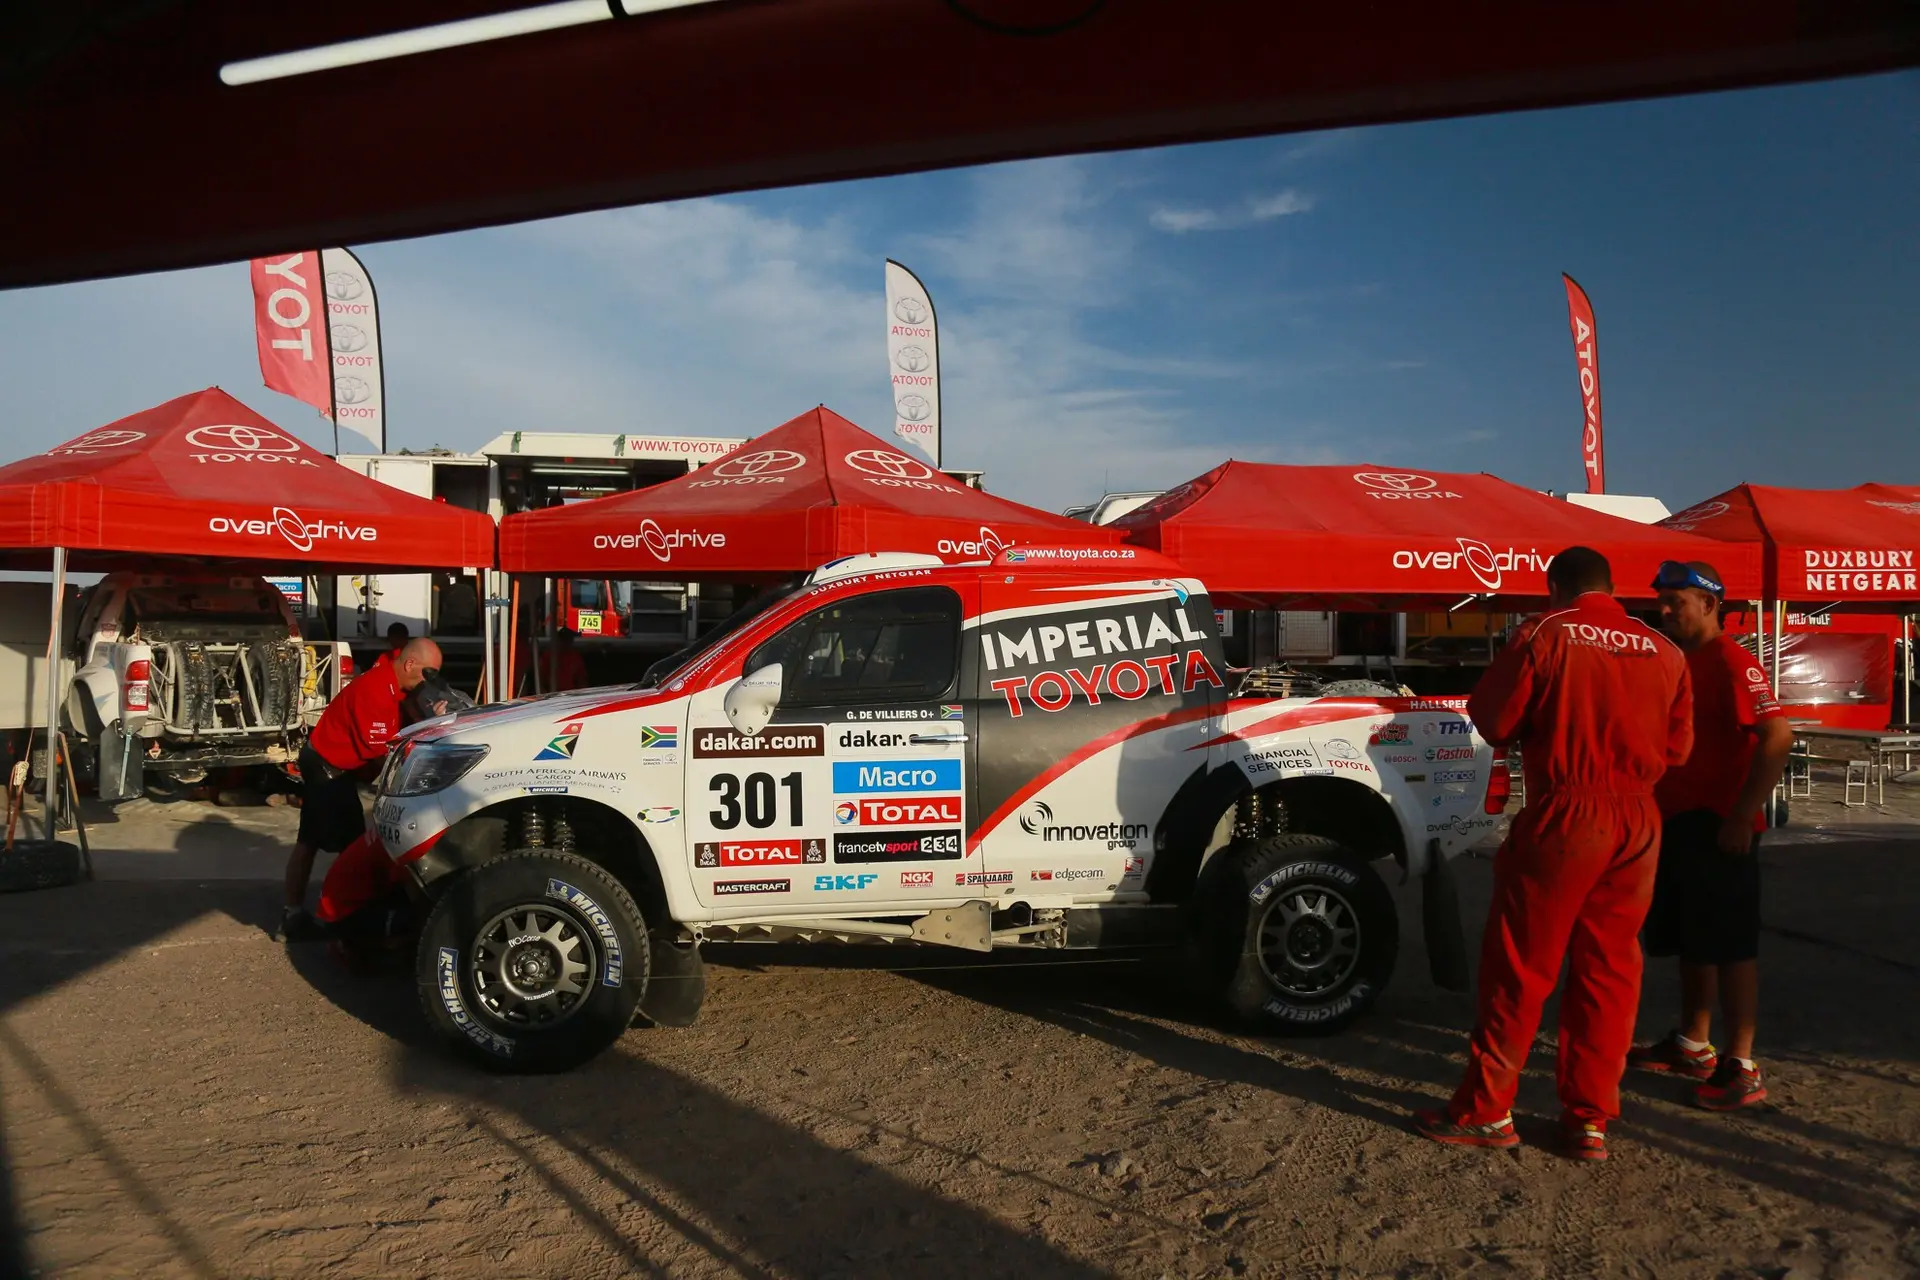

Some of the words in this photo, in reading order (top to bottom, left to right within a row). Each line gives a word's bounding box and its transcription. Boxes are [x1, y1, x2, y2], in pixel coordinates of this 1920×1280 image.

[189, 453, 320, 468] TOYOTA
[688, 477, 785, 489] TOYOTA
[864, 478, 963, 495] TOYOTA
[1025, 548, 1135, 561] www.toyota.co.za
[1497, 547, 1556, 572] driv
[1805, 550, 1914, 568] DUXBURY
[810, 576, 868, 596] DUXBURY
[875, 569, 932, 580] NETGEAR
[1806, 574, 1917, 591] NETGEAR
[581, 617, 599, 628] 745
[981, 608, 1208, 671] IMPERIAL
[1562, 623, 1658, 654] TOYOTA
[990, 649, 1225, 718] TOYOTA
[1410, 700, 1468, 710] HALLSPEE
[846, 710, 857, 720] G.
[859, 710, 872, 720] DE
[875, 709, 918, 720] VILLIERS
[1438, 721, 1474, 735] TFM
[699, 732, 817, 751] dakar.com
[1243, 748, 1313, 763] FINANCIAL
[1392, 755, 1418, 763] BOSCH
[1436, 747, 1475, 761] Castrol
[1247, 759, 1313, 774] SERVICES
[1327, 759, 1372, 773] TOYOTA
[484, 769, 523, 781] SOUTH
[580, 769, 627, 781] AIRWAYS
[858, 766, 937, 787] Macro
[709, 772, 803, 830] 301
[863, 803, 958, 821] TOTAL
[1043, 822, 1149, 842] innovation
[723, 843, 800, 861] TOTAL
[838, 839, 919, 854] francetvsport
[1107, 840, 1137, 850] group
[902, 872, 932, 883] NGK
[967, 873, 1013, 884] SPANJAARD
[1055, 868, 1103, 880] edgecam
[1271, 863, 1356, 886] MICHELIN
[716, 882, 787, 893] MASTERCRAFT
[814, 874, 878, 891] SKF
[570, 892, 621, 987] MICHELIN
[440, 950, 490, 1045] MICHELIN
[1266, 997, 1352, 1021] MICHELIN
